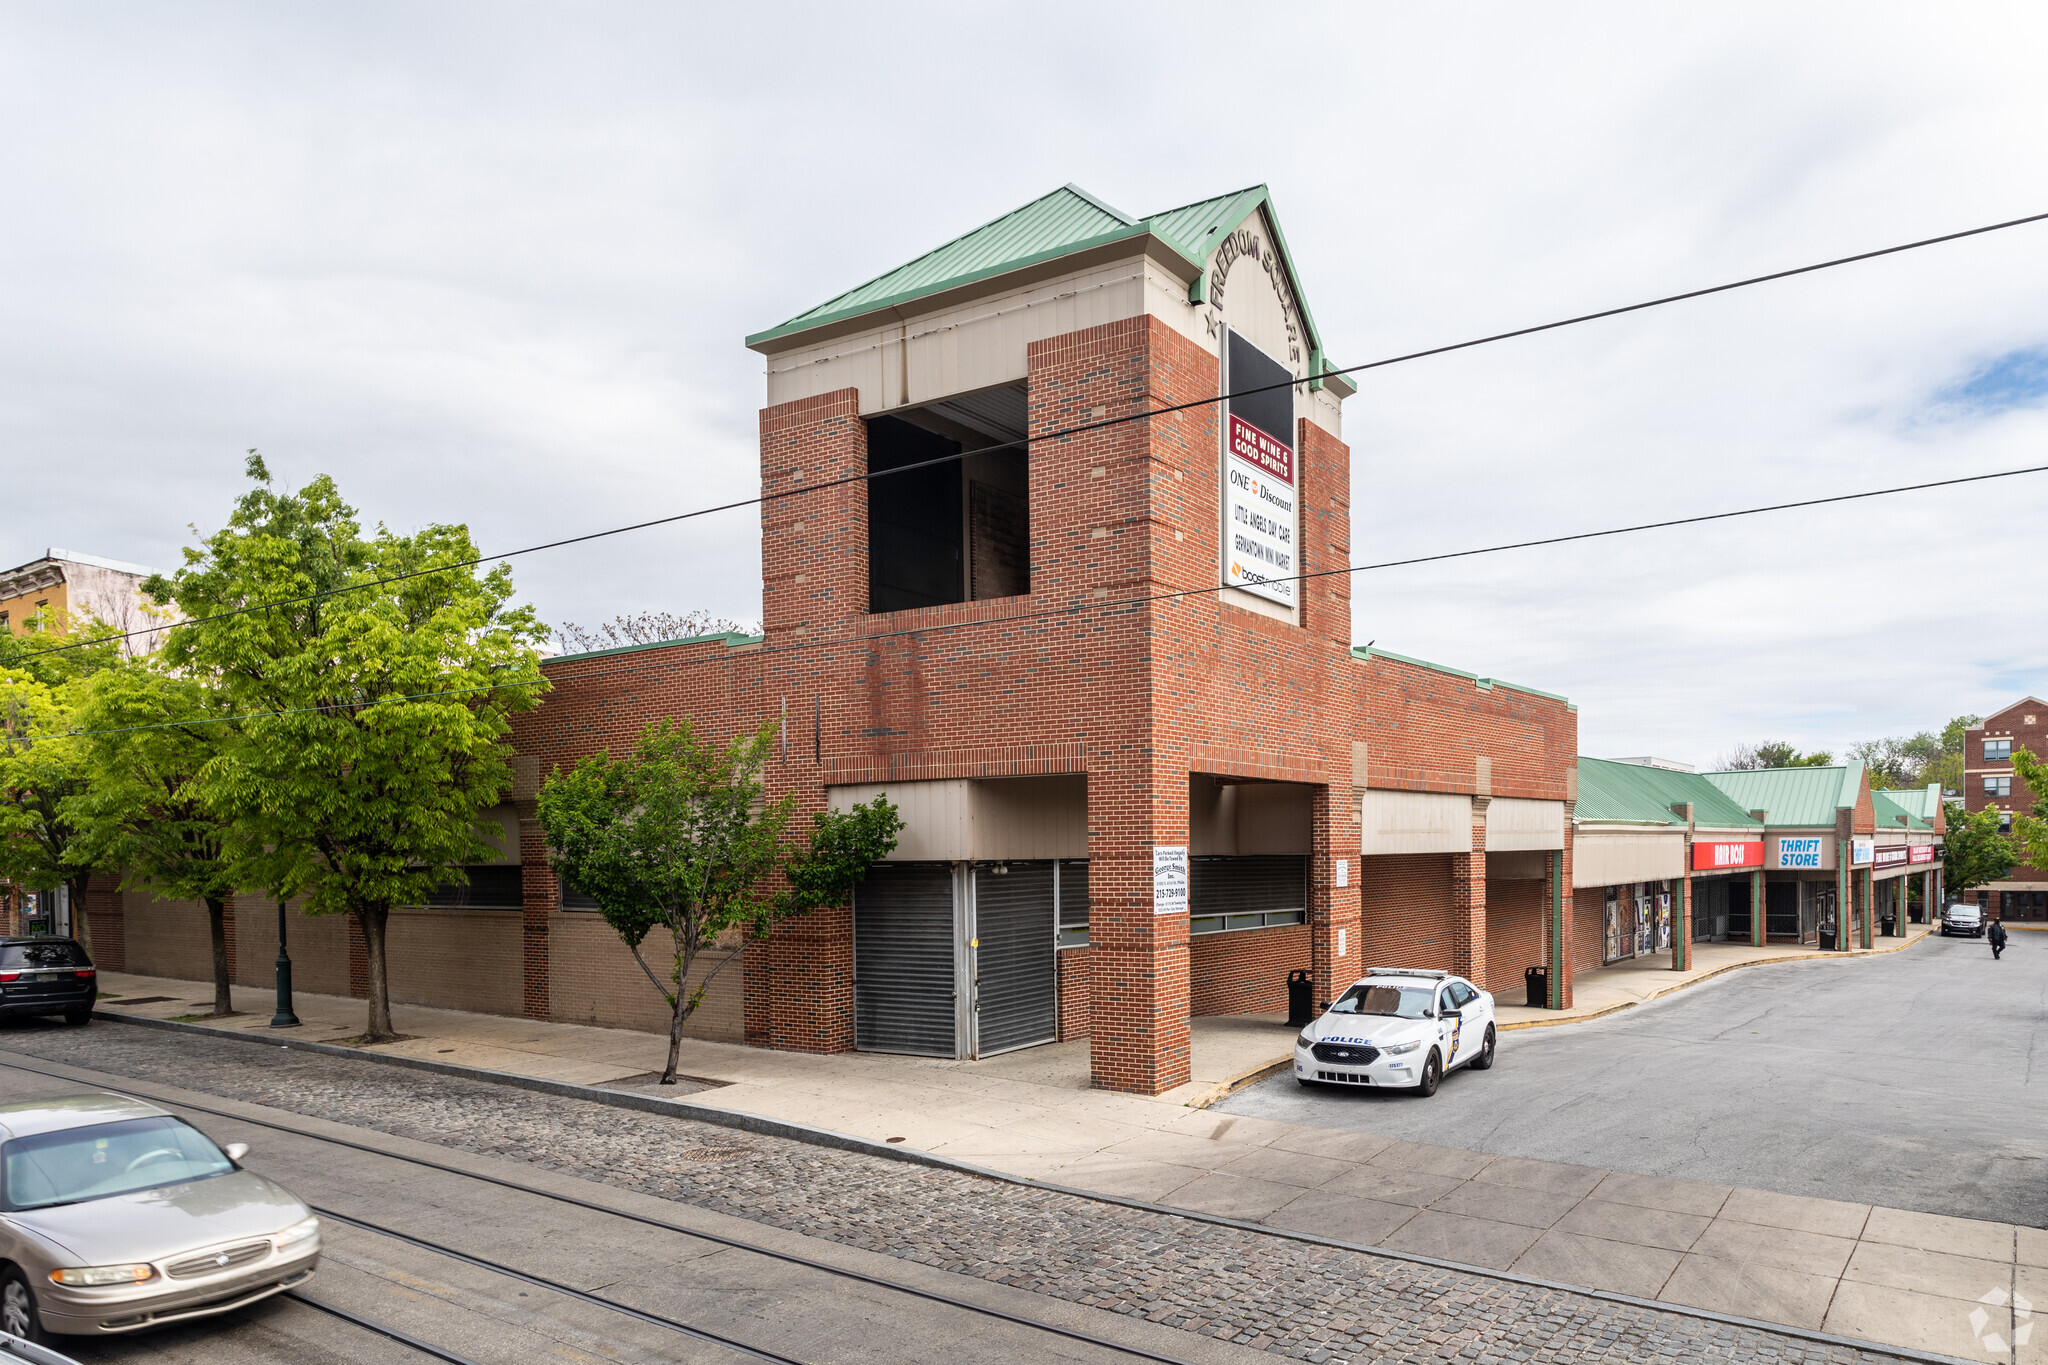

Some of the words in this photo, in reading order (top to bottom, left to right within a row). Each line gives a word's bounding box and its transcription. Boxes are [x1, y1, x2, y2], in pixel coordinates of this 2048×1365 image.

[1210, 229, 1260, 311] FREEDOM
[1262, 249, 1300, 363] SQUARE
[1235, 438, 1259, 460] GOOD
[1260, 452, 1288, 477] SPIRITS
[1236, 423, 1256, 445] FINE
[1259, 436, 1280, 459] WINE
[1283, 451, 1288, 463] &
[1230, 469, 1250, 491] ONE
[1260, 484, 1292, 512] Discount
[1234, 503, 1248, 525] LITTLE
[1249, 511, 1267, 533] ANGELS
[1268, 520, 1277, 538] DAY
[1279, 525, 1290, 544] CARE
[1730, 844, 1745, 865] BOSS
[1781, 840, 1820, 852] THRIFT
[1781, 853, 1819, 866] STORE
[1172, 863, 1186, 873] Smith
[1321, 1036, 1373, 1045] POLICE
